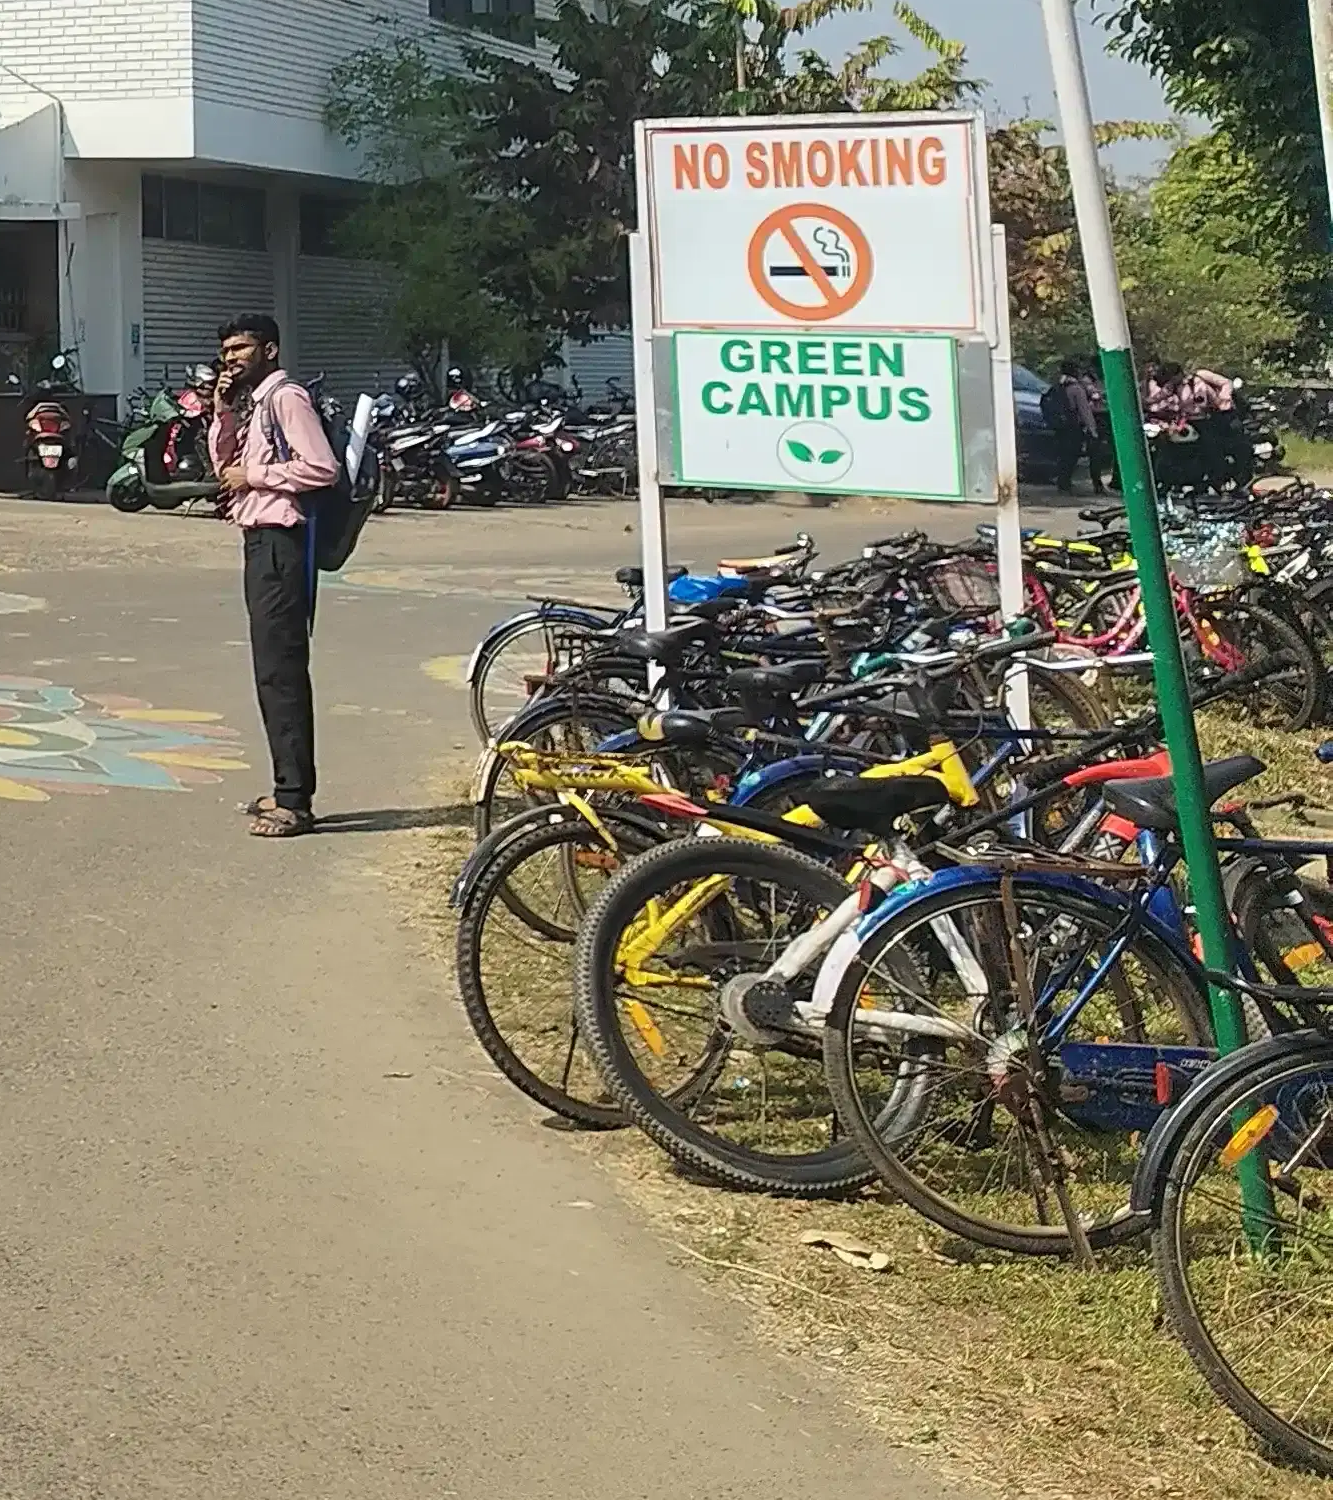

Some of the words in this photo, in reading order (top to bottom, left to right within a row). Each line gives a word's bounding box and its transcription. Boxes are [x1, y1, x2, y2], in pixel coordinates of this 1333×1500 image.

[673, 143, 731, 191] NO
[745, 136, 948, 190] SMOKING
[720, 339, 906, 378] GREEN
[701, 381, 932, 424] CAMPUS
